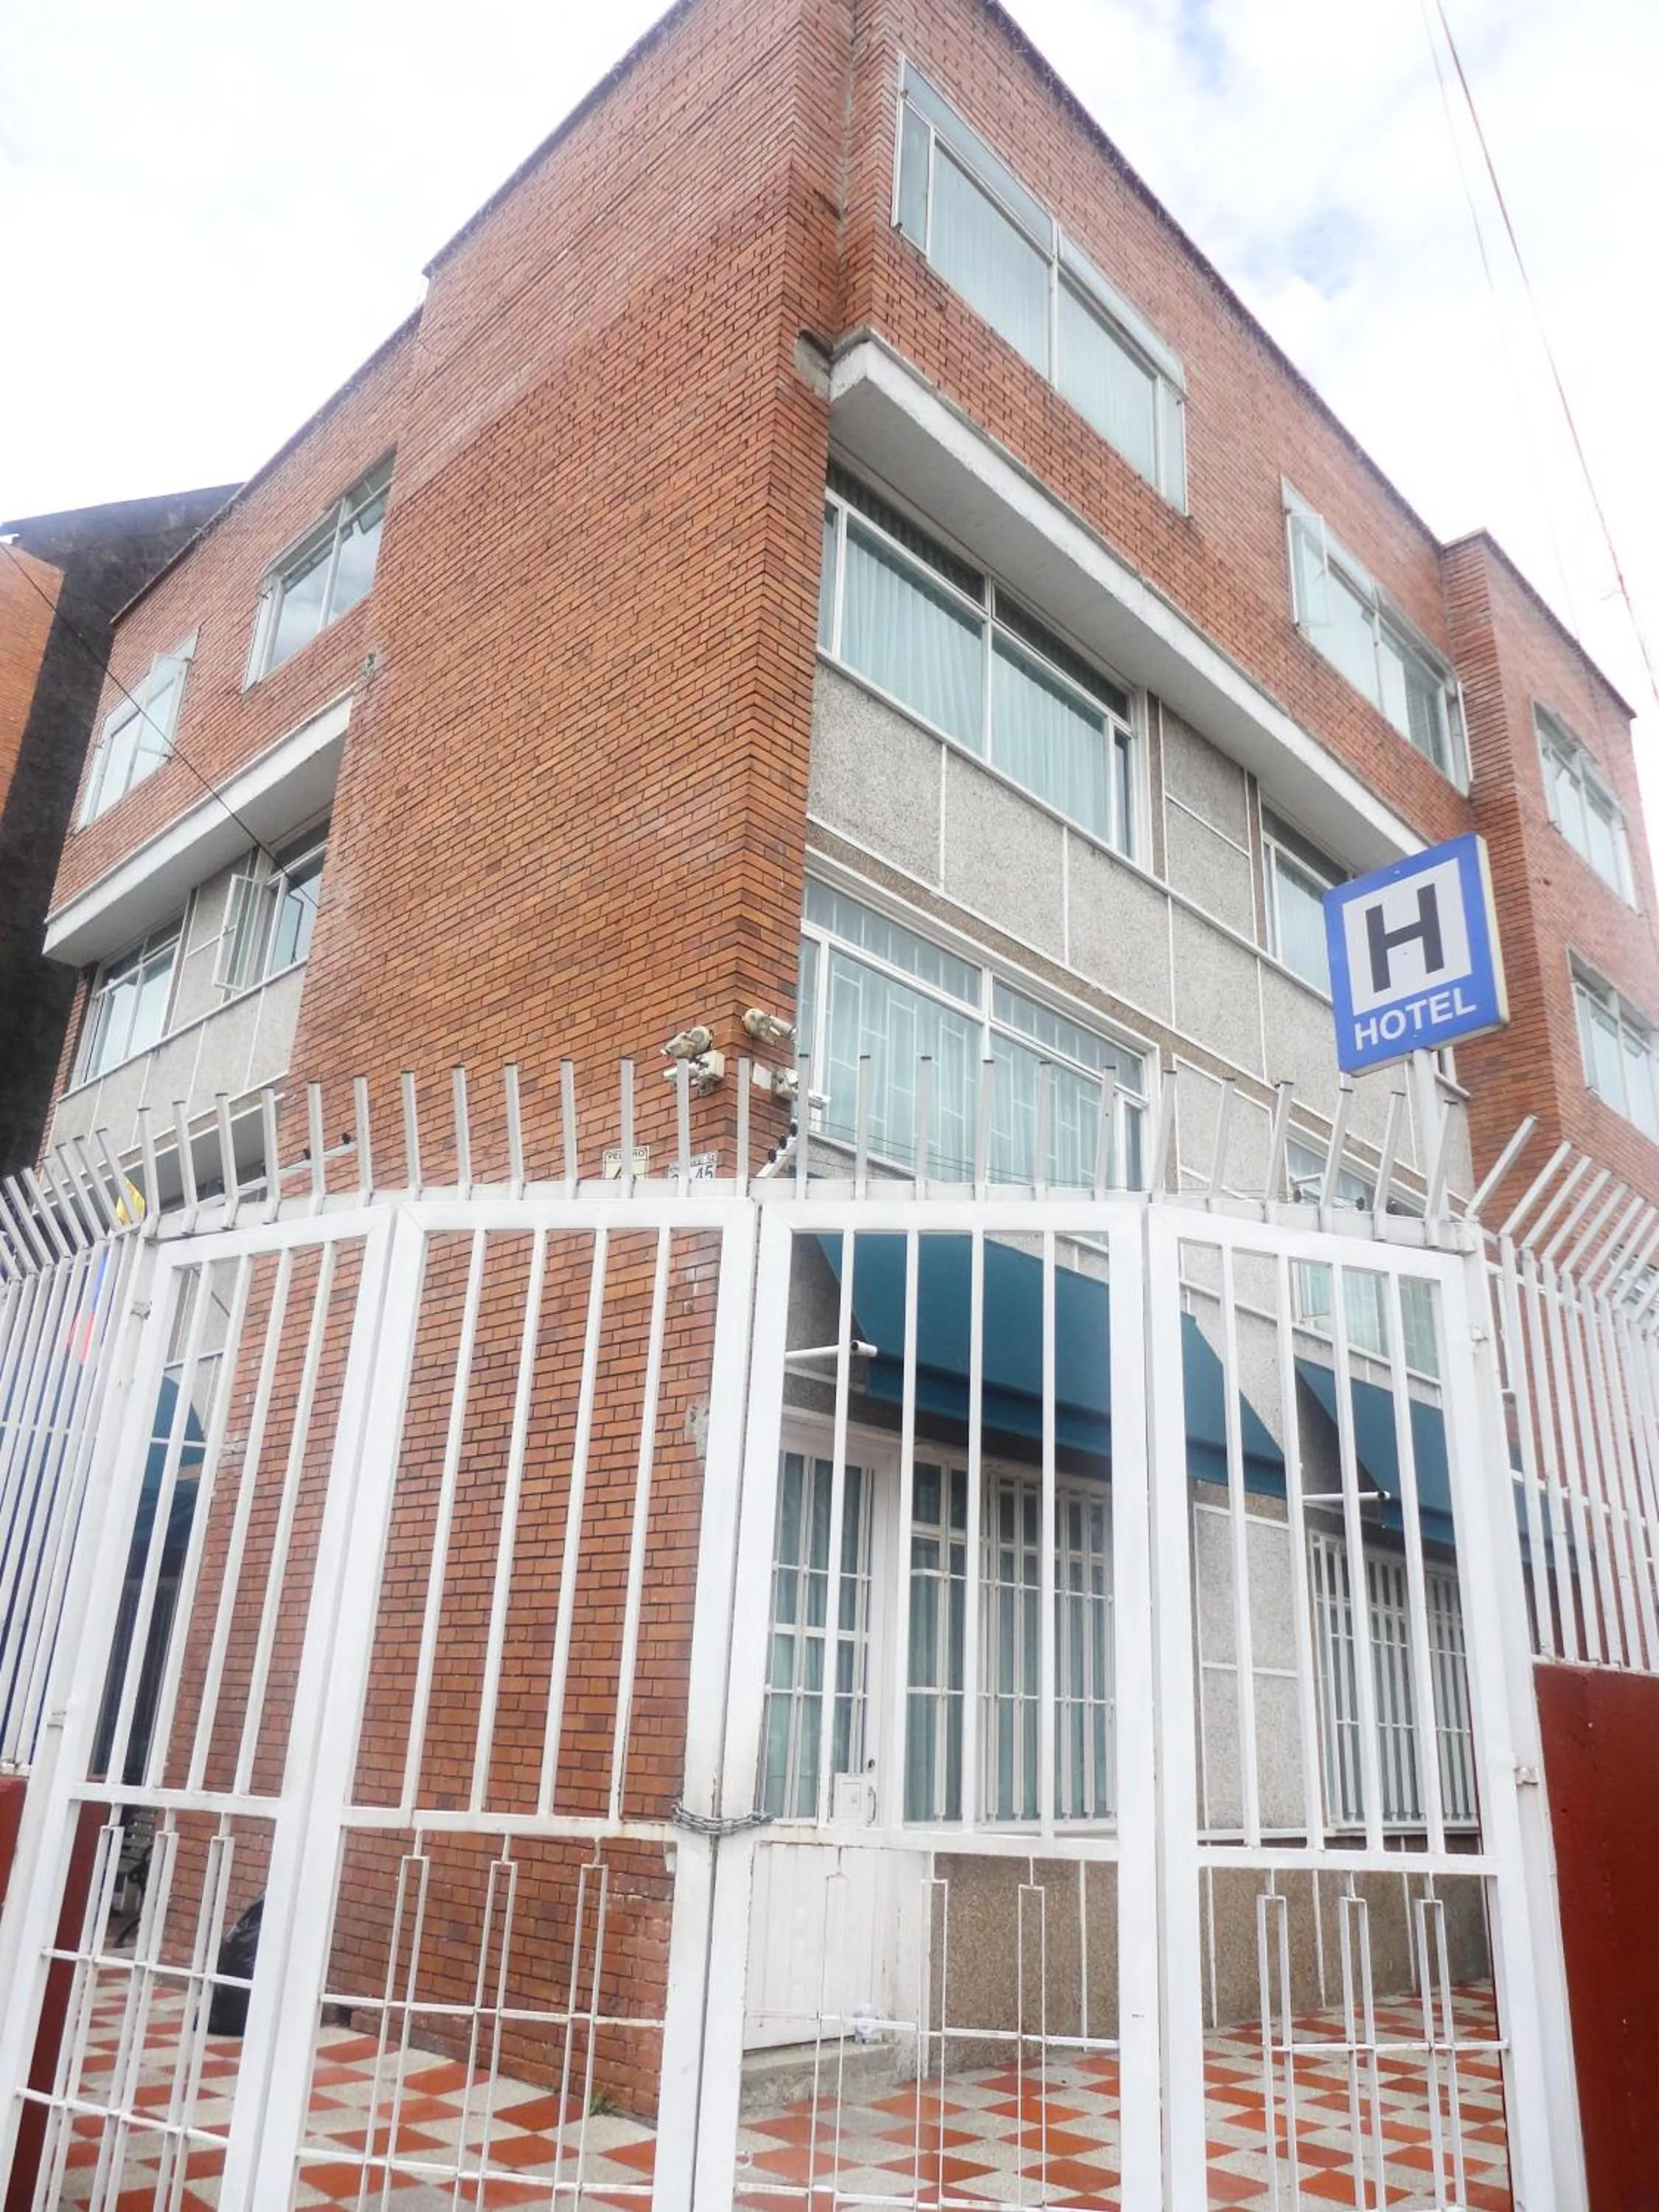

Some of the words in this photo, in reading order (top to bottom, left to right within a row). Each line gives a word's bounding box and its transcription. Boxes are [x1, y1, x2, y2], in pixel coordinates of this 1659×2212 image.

[1366, 883, 1444, 993] H
[1354, 987, 1476, 1050] HOTEL
[608, 1150, 645, 1160] PELRO
